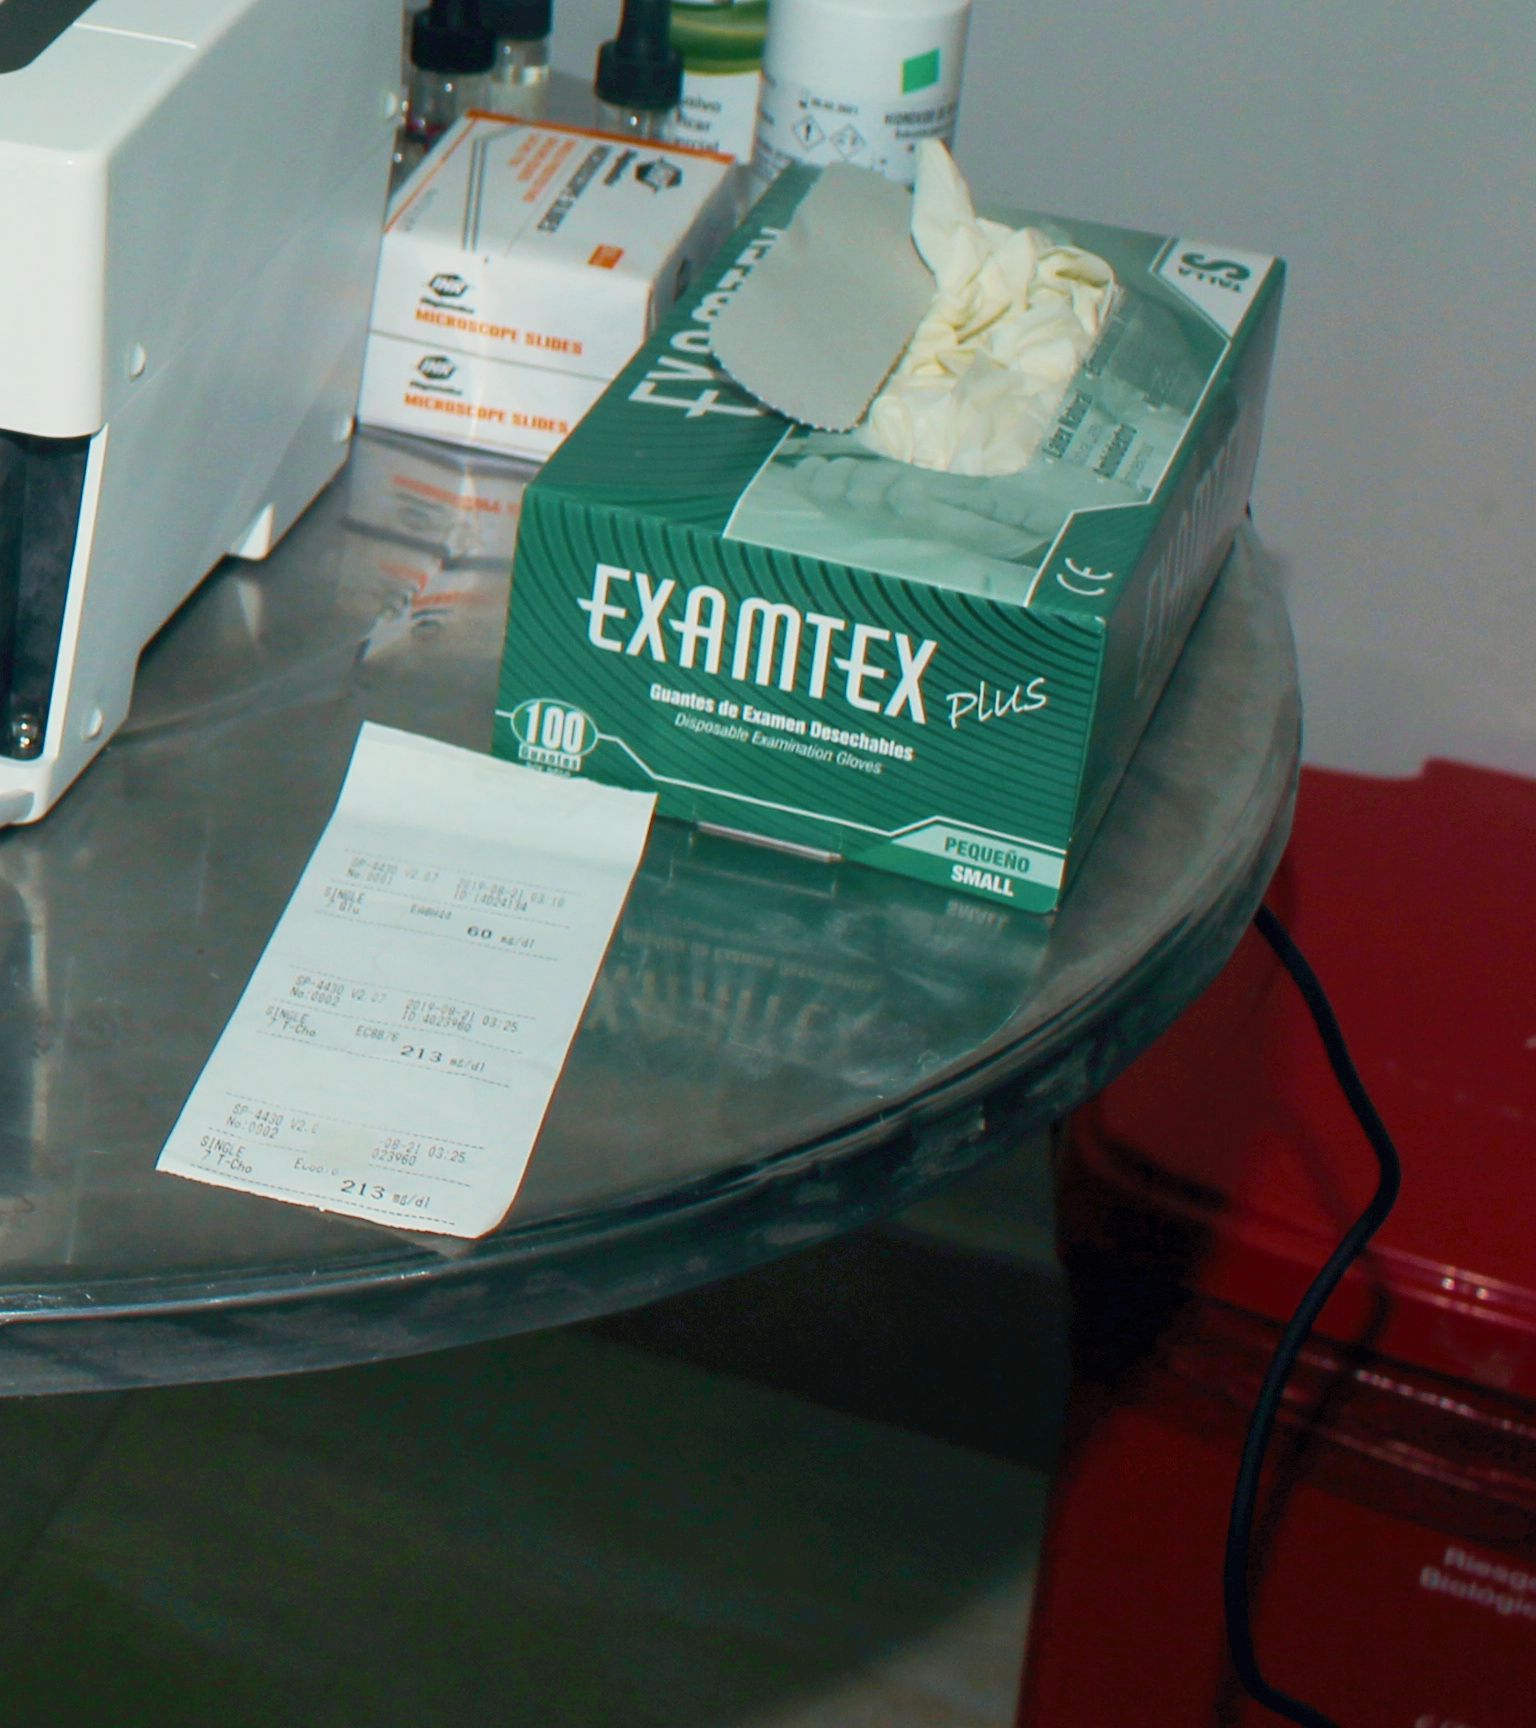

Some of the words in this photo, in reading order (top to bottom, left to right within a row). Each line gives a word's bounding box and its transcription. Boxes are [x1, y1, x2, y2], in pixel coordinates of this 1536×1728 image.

[415, 308, 519, 343] MICROSCOPE
[525, 333, 584, 356] SLIDES
[404, 393, 507, 425] MICROSCOPE
[512, 412, 569, 435] SLIDES
[577, 563, 938, 726] EXAMTEX
[525, 700, 586, 754] 100
[649, 682, 715, 715] Guantes
[718, 699, 739, 720] de
[742, 707, 809, 735] Examen
[809, 719, 916, 763] Desechables
[675, 711, 749, 743] Disposable
[751, 729, 833, 762] Examination
[836, 749, 884, 775] Gloves
[944, 835, 1031, 874] PEQUEÑO
[324, 885, 366, 905] SINGLE
[951, 864, 1015, 898] SMALL
[467, 925, 493, 940] 60
[265, 1005, 310, 1024] SINGLE
[294, 974, 346, 995] SP-4430
[404, 998, 477, 1022] 2019-08-21
[481, 1014, 519, 1034] 03:25
[281, 1021, 317, 1038] T-Cho
[400, 1044, 444, 1064] 213
[199, 1135, 247, 1158] SINGLE
[226, 1115, 280, 1140] No:0002
[428, 1145, 467, 1164] 03:25
[217, 1152, 254, 1174] T-Cho
[340, 1178, 387, 1200] 213
[393, 1192, 431, 1209] mg/dl
